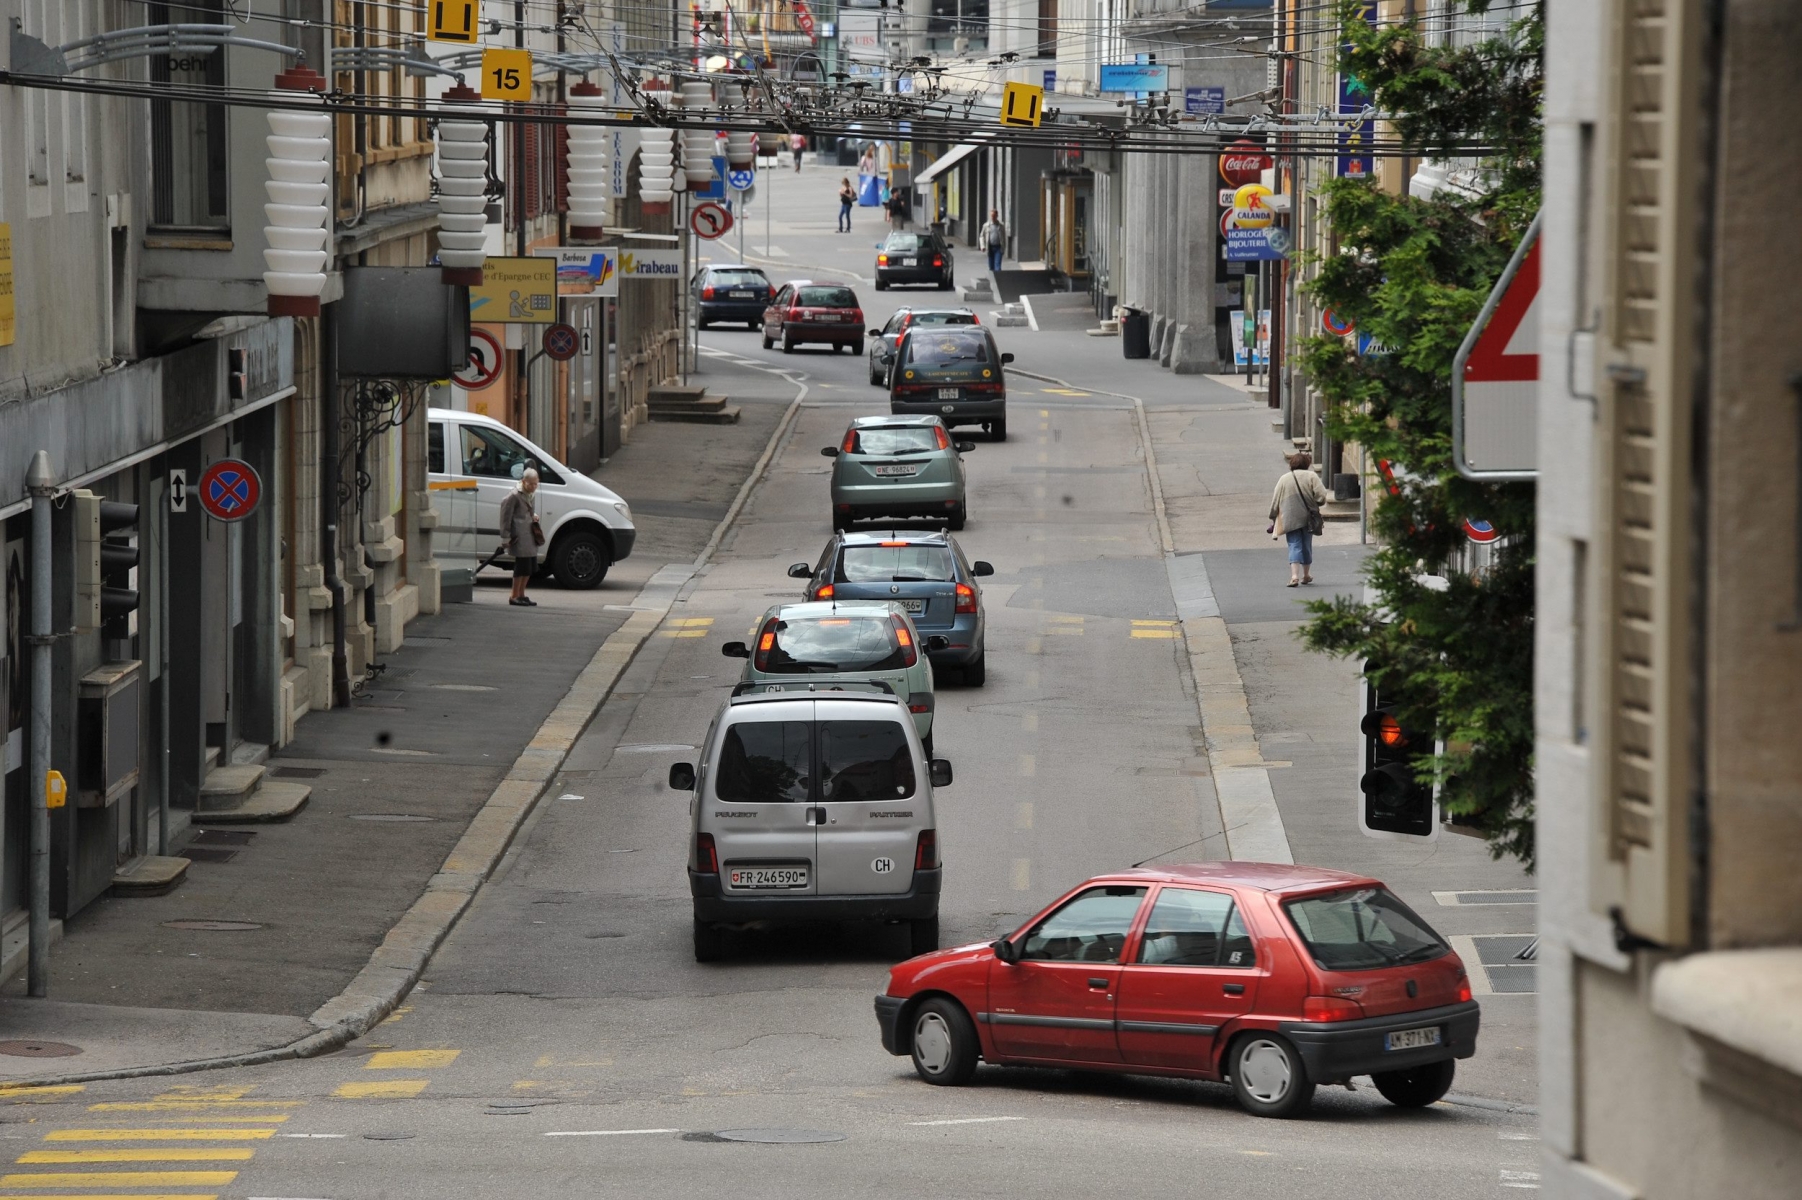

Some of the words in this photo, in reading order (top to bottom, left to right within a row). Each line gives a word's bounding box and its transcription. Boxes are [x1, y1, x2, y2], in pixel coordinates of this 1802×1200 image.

[855, 36, 875, 45] UBS
[492, 68, 520, 90] 15
[613, 131, 622, 195] TEA-ROOM
[1225, 157, 1262, 171] Coca-Cola
[1221, 193, 1234, 204] CAS
[1237, 211, 1271, 220] CALANDA
[1228, 239, 1267, 249] BIJOUTERIE
[562, 253, 587, 262] Barbosa
[618, 252, 679, 275] Mirabeau
[490, 271, 532, 282] d'Epargne
[533, 272, 551, 281] CEC
[875, 859, 890, 872] CH
